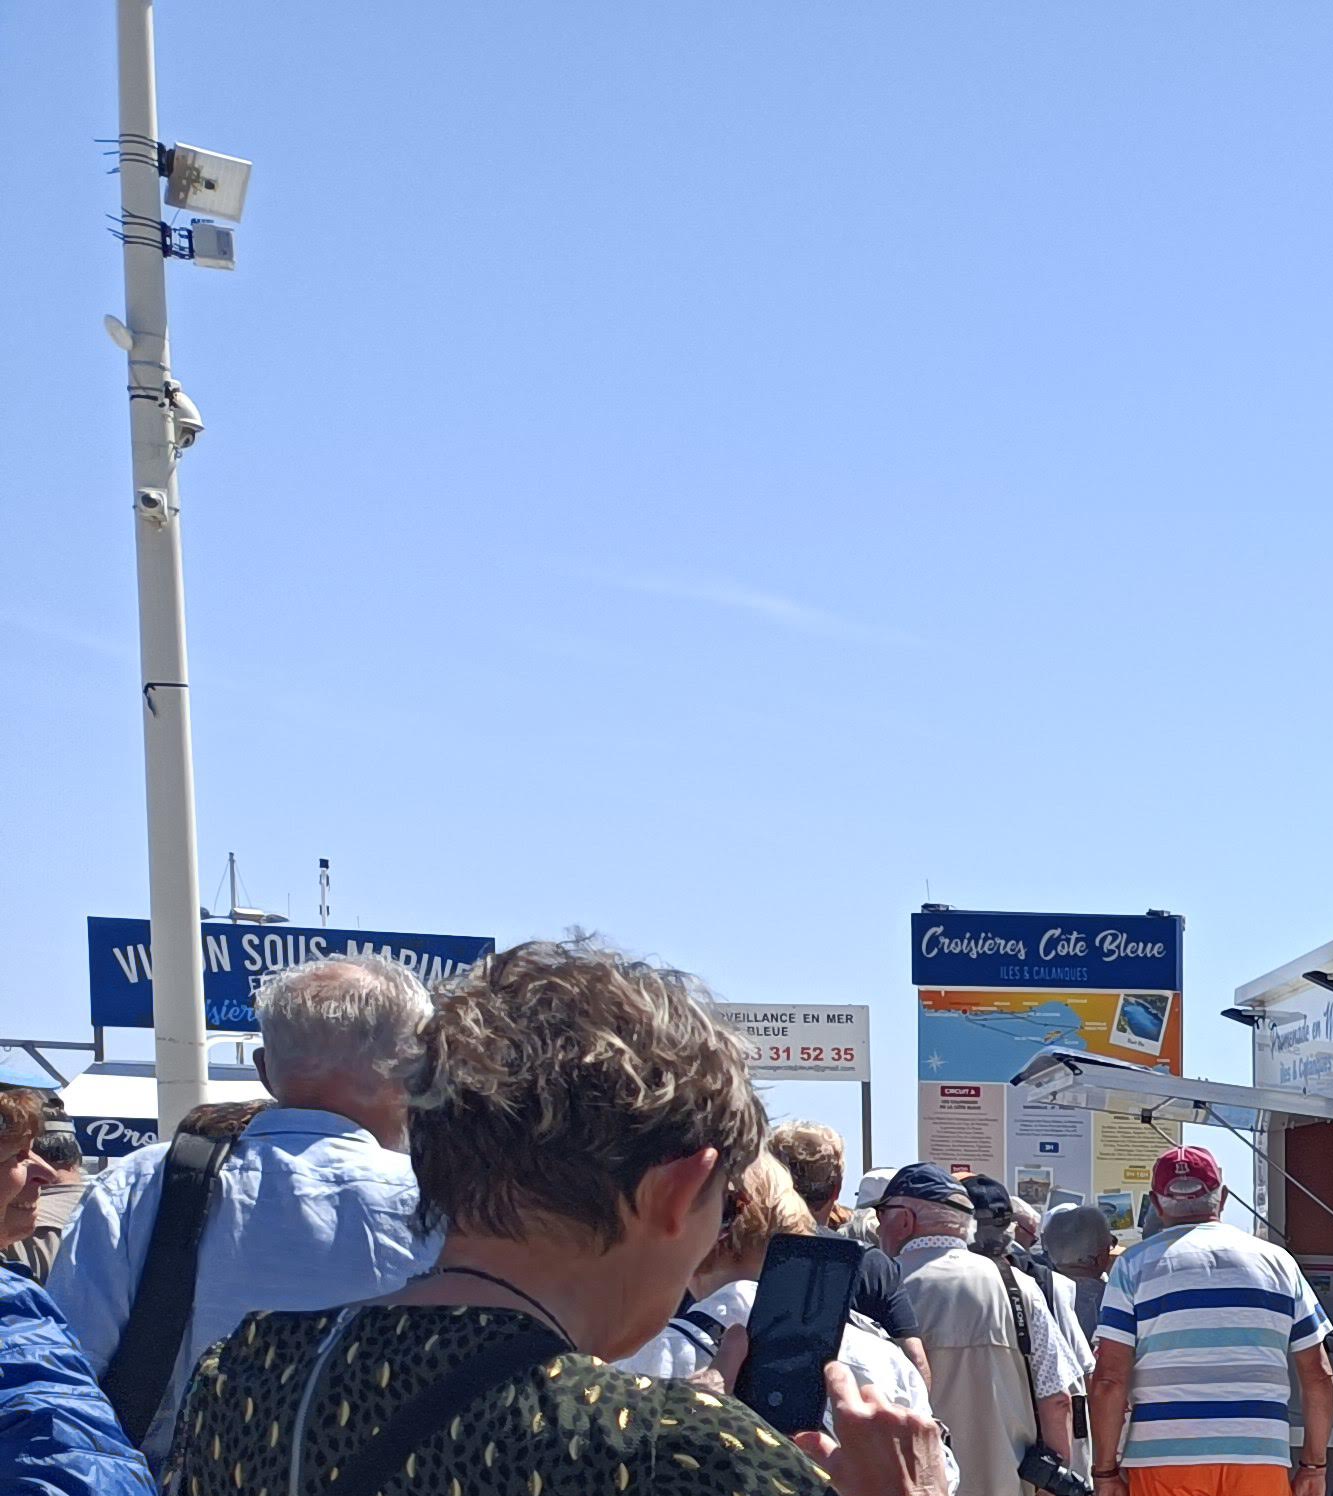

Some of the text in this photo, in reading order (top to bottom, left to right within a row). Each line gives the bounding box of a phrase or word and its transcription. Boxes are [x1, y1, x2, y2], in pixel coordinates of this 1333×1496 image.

[921, 926, 1166, 961] Croisières Côte Bleue
[1034, 966, 1088, 981] CALANQUES
[803, 1014, 820, 1023] EN
[827, 1014, 854, 1024] MER
[747, 1026, 789, 1037] BLEUE
[769, 1046, 791, 1061] 31
[800, 1046, 824, 1061] 52
[831, 1047, 855, 1062] 35
